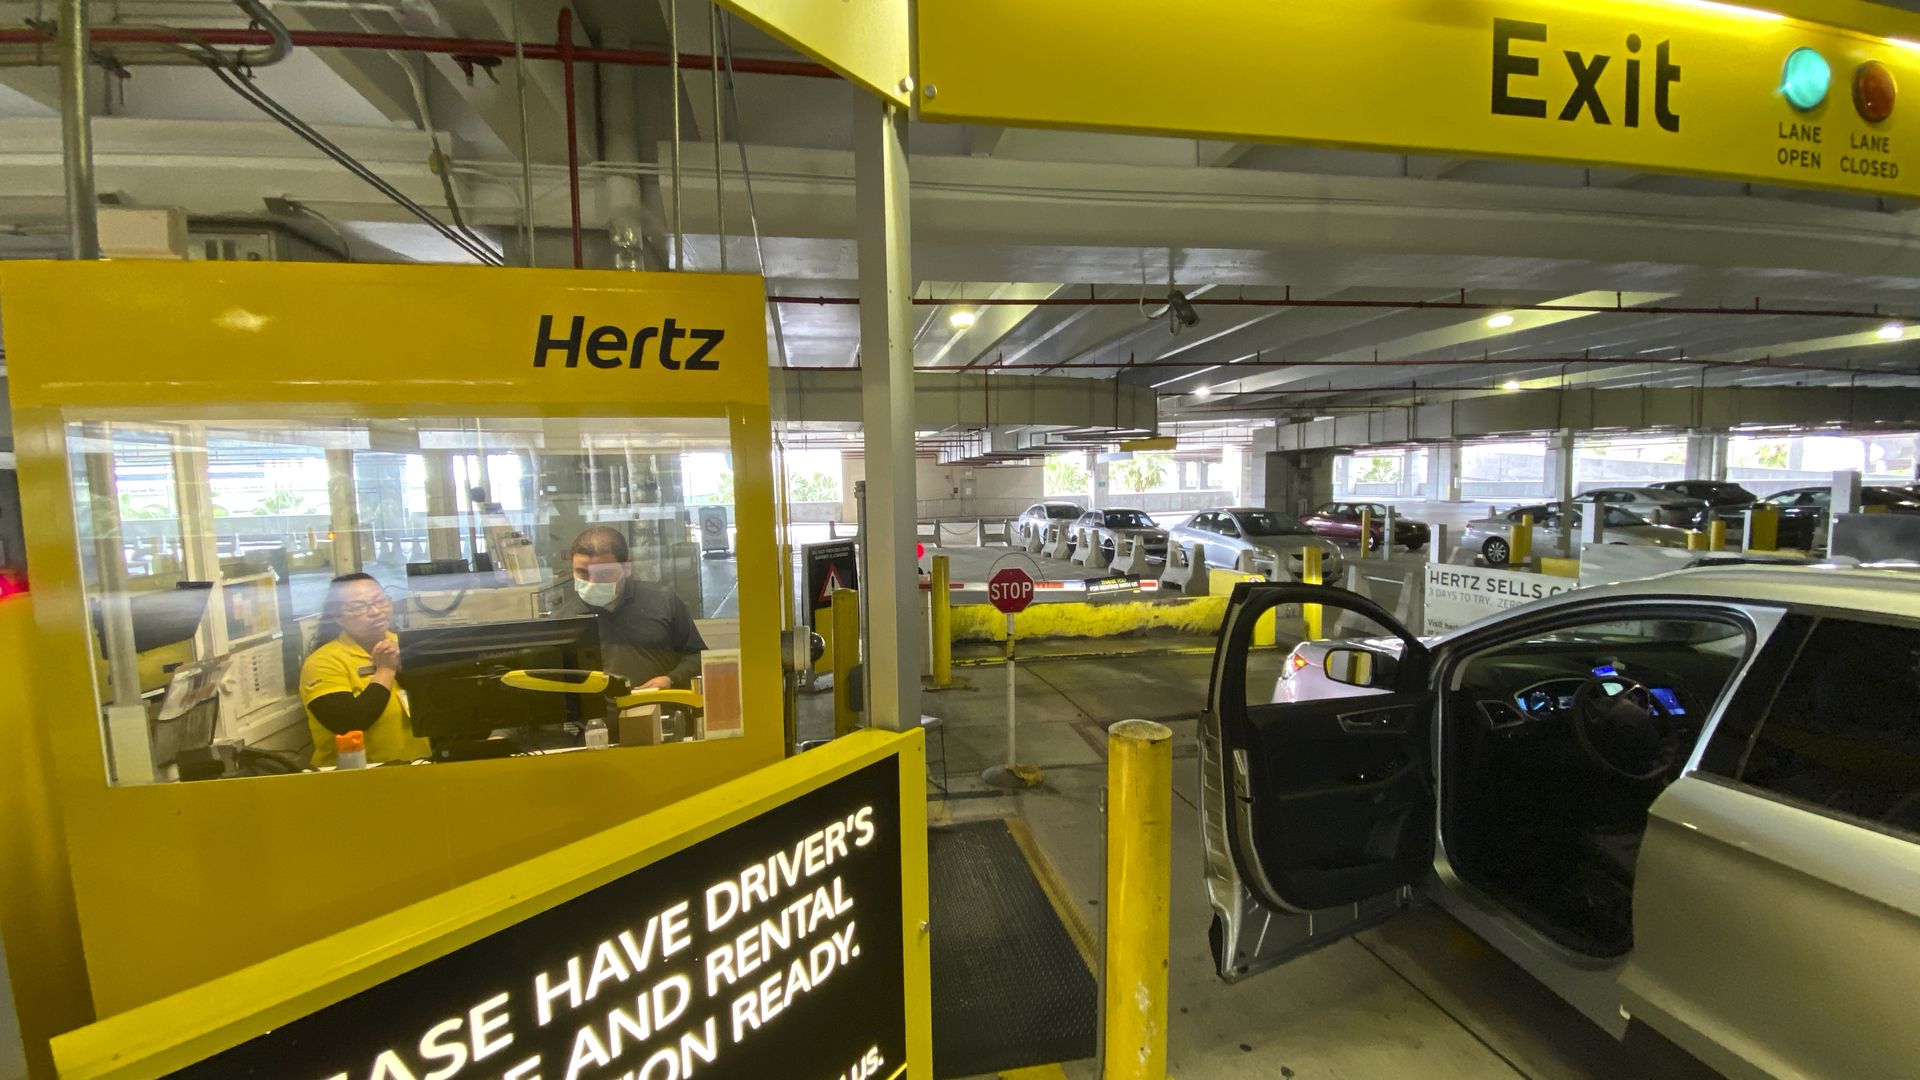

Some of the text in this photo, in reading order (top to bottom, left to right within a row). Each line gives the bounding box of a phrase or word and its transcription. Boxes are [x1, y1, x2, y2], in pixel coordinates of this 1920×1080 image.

[1491, 17, 1681, 132] Exit
[1778, 122, 1822, 143] LANE
[1850, 132, 1890, 154] LANE
[1777, 148, 1822, 169] OPEN
[1840, 156, 1899, 179] CLOSED
[533, 314, 725, 370] Hertz
[991, 582, 1031, 600] STOP
[1428, 587, 1434, 598] 3
[1435, 588, 1458, 601] DAYS
[1460, 592, 1471, 602] TO
[1430, 570, 1574, 600] HERTZ SELLS C
[535, 900, 692, 1027] HAVE
[705, 806, 875, 932] DRIVER'S
[564, 876, 854, 1080] AND RENTAL
[733, 922, 860, 1043] READY.
